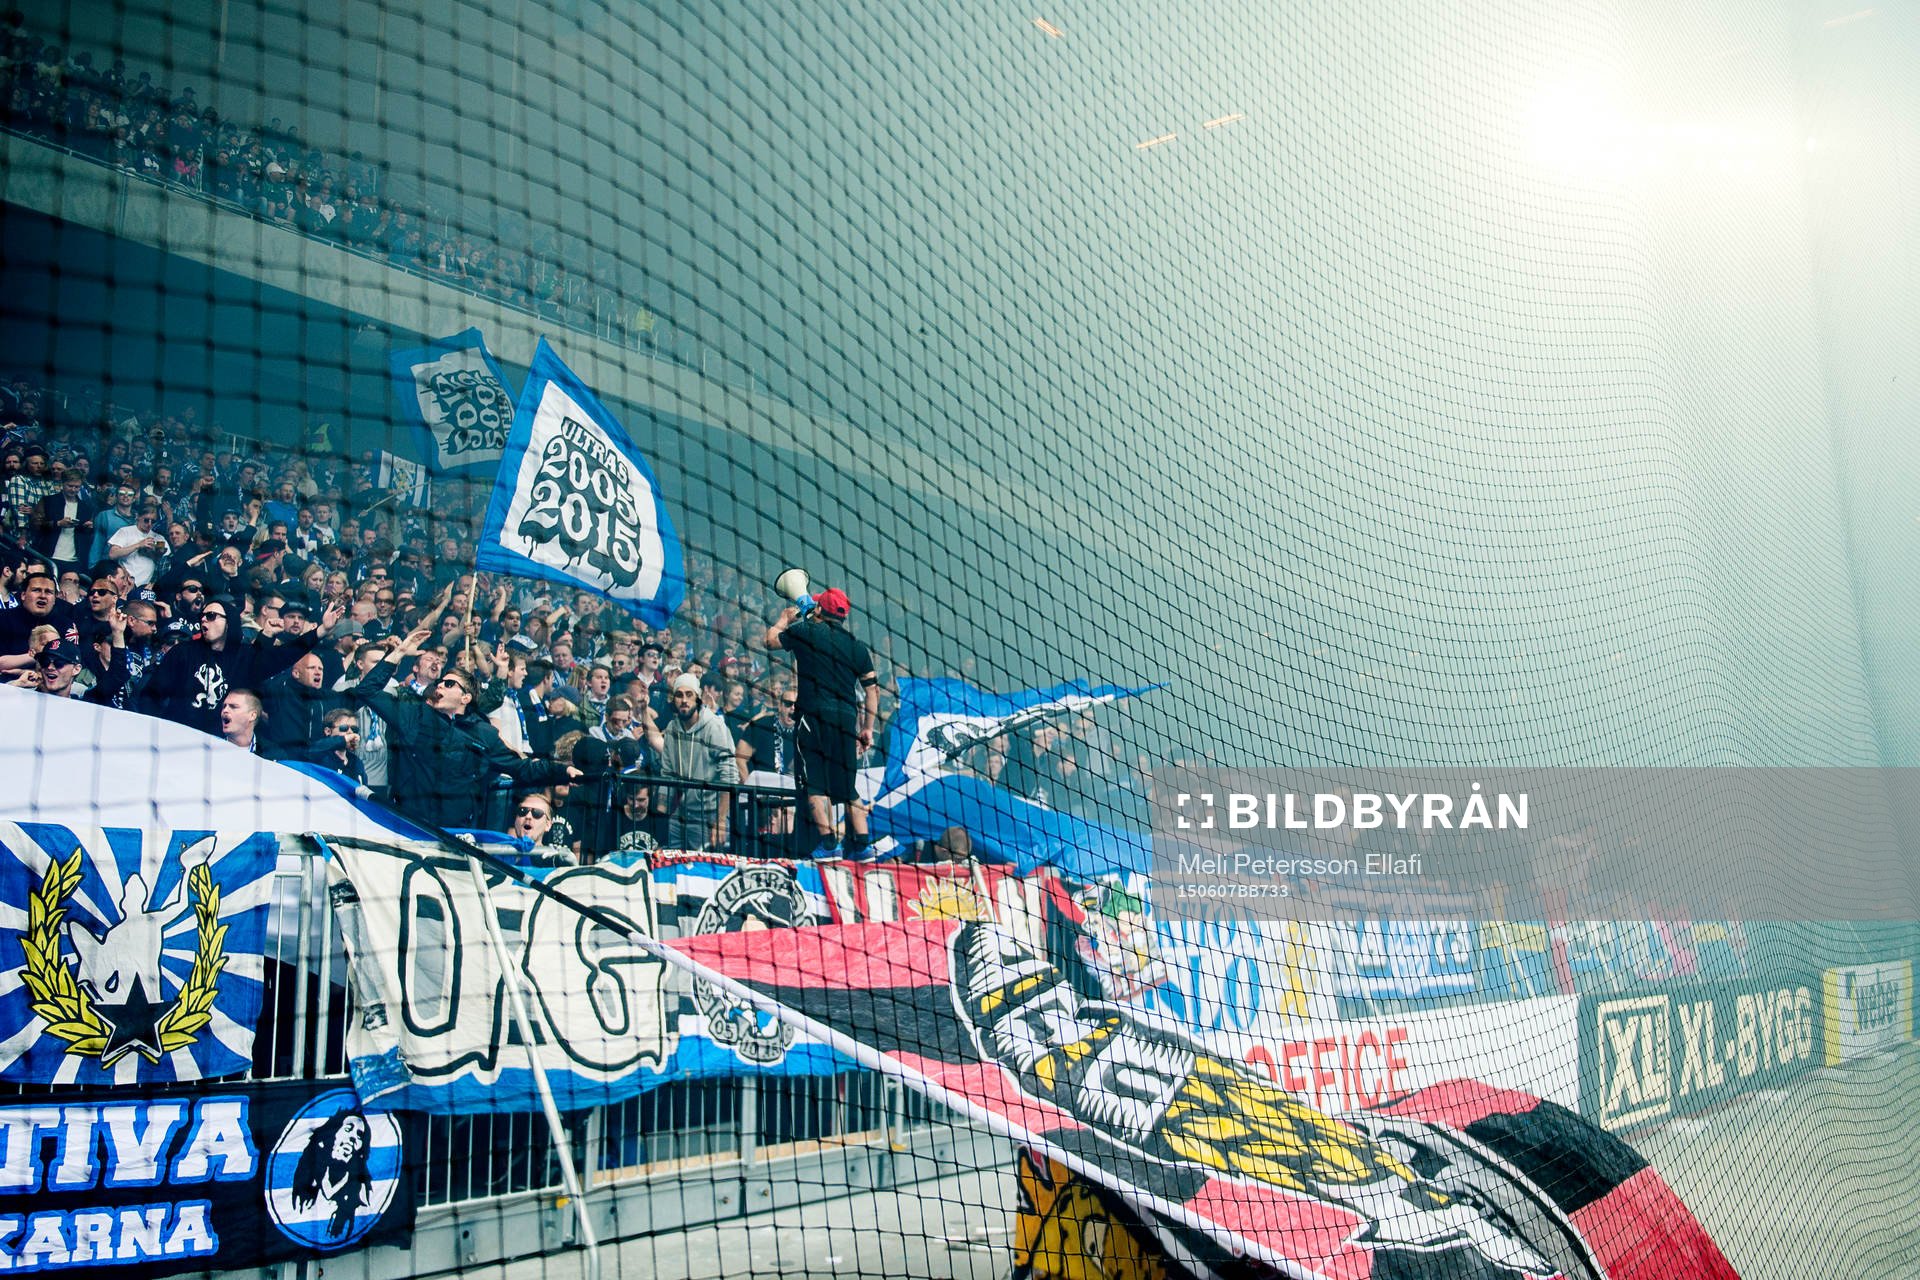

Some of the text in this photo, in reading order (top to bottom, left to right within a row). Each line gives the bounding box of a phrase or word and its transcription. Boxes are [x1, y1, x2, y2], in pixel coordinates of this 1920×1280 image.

[541, 437, 638, 526] 2005
[562, 420, 628, 485] ULTRAS
[522, 479, 640, 573] 2015
[1604, 1012, 1665, 1110] XL
[1678, 986, 1812, 1097] XL-BYGG
[0, 1102, 251, 1187] TIVA
